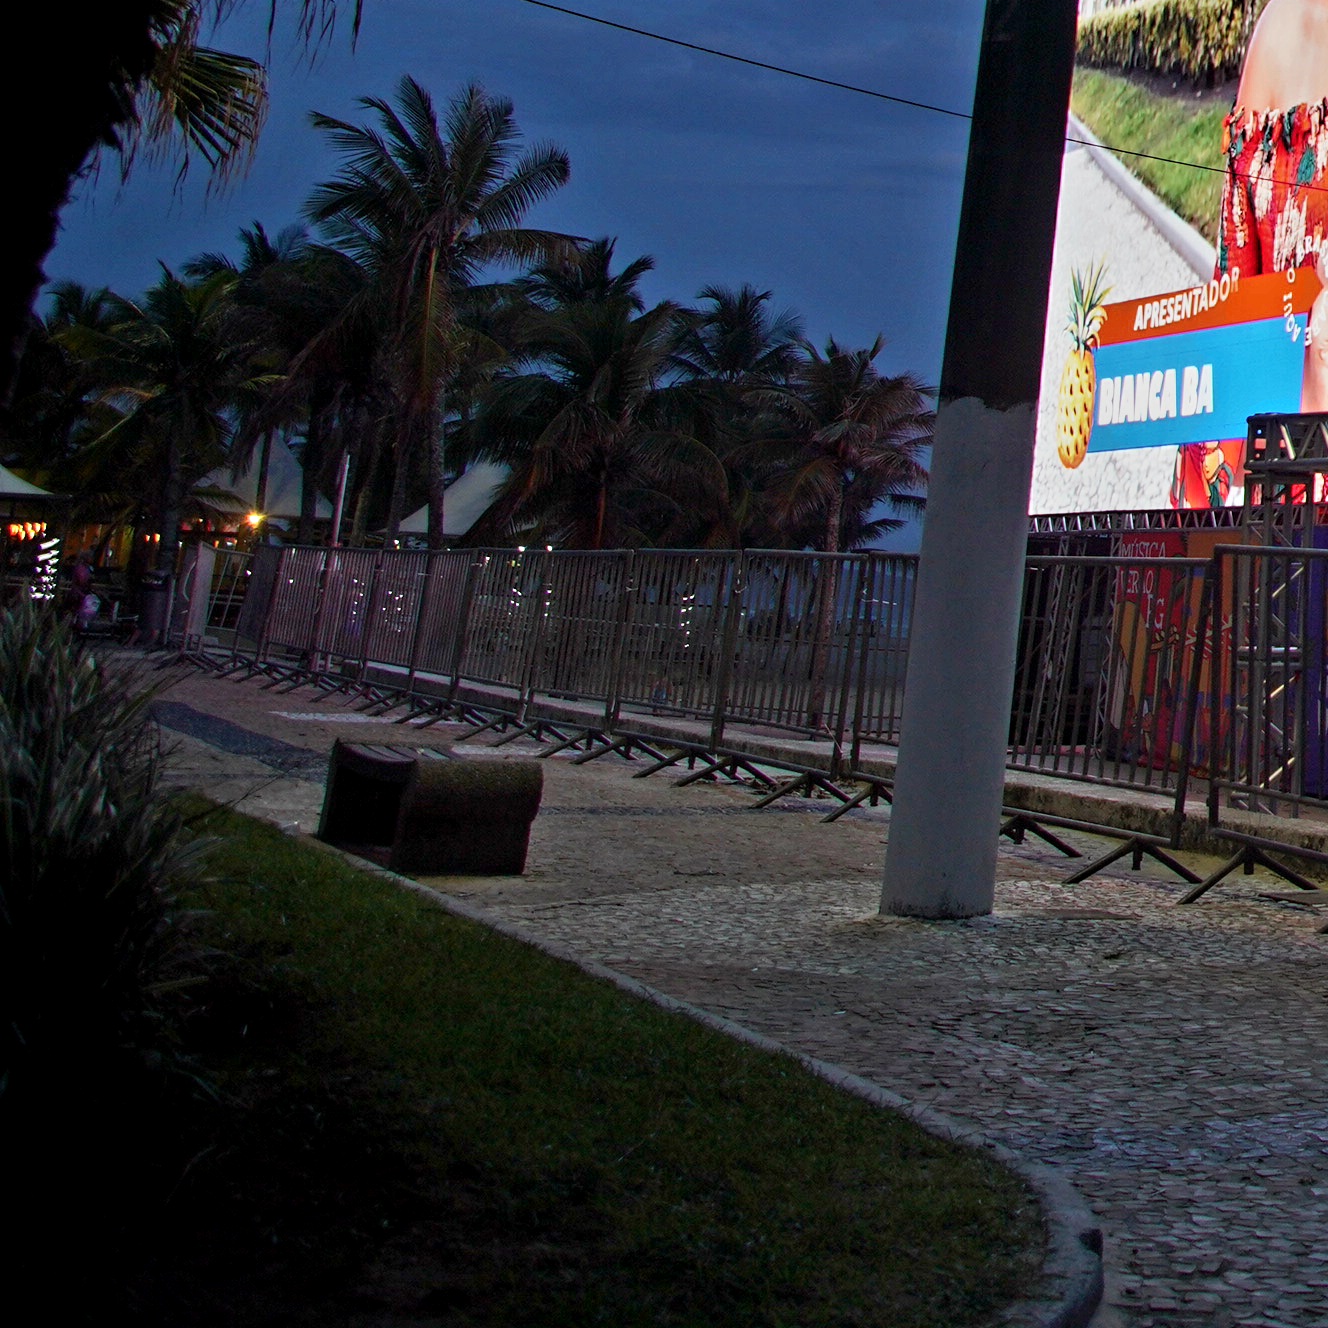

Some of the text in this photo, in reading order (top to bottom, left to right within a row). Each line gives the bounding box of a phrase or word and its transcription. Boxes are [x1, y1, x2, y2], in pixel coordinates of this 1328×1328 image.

[1133, 266, 1240, 331] APRESENTADOR
[1098, 363, 1214, 426] BIANCA BA
[1117, 568, 1154, 594] VERO
